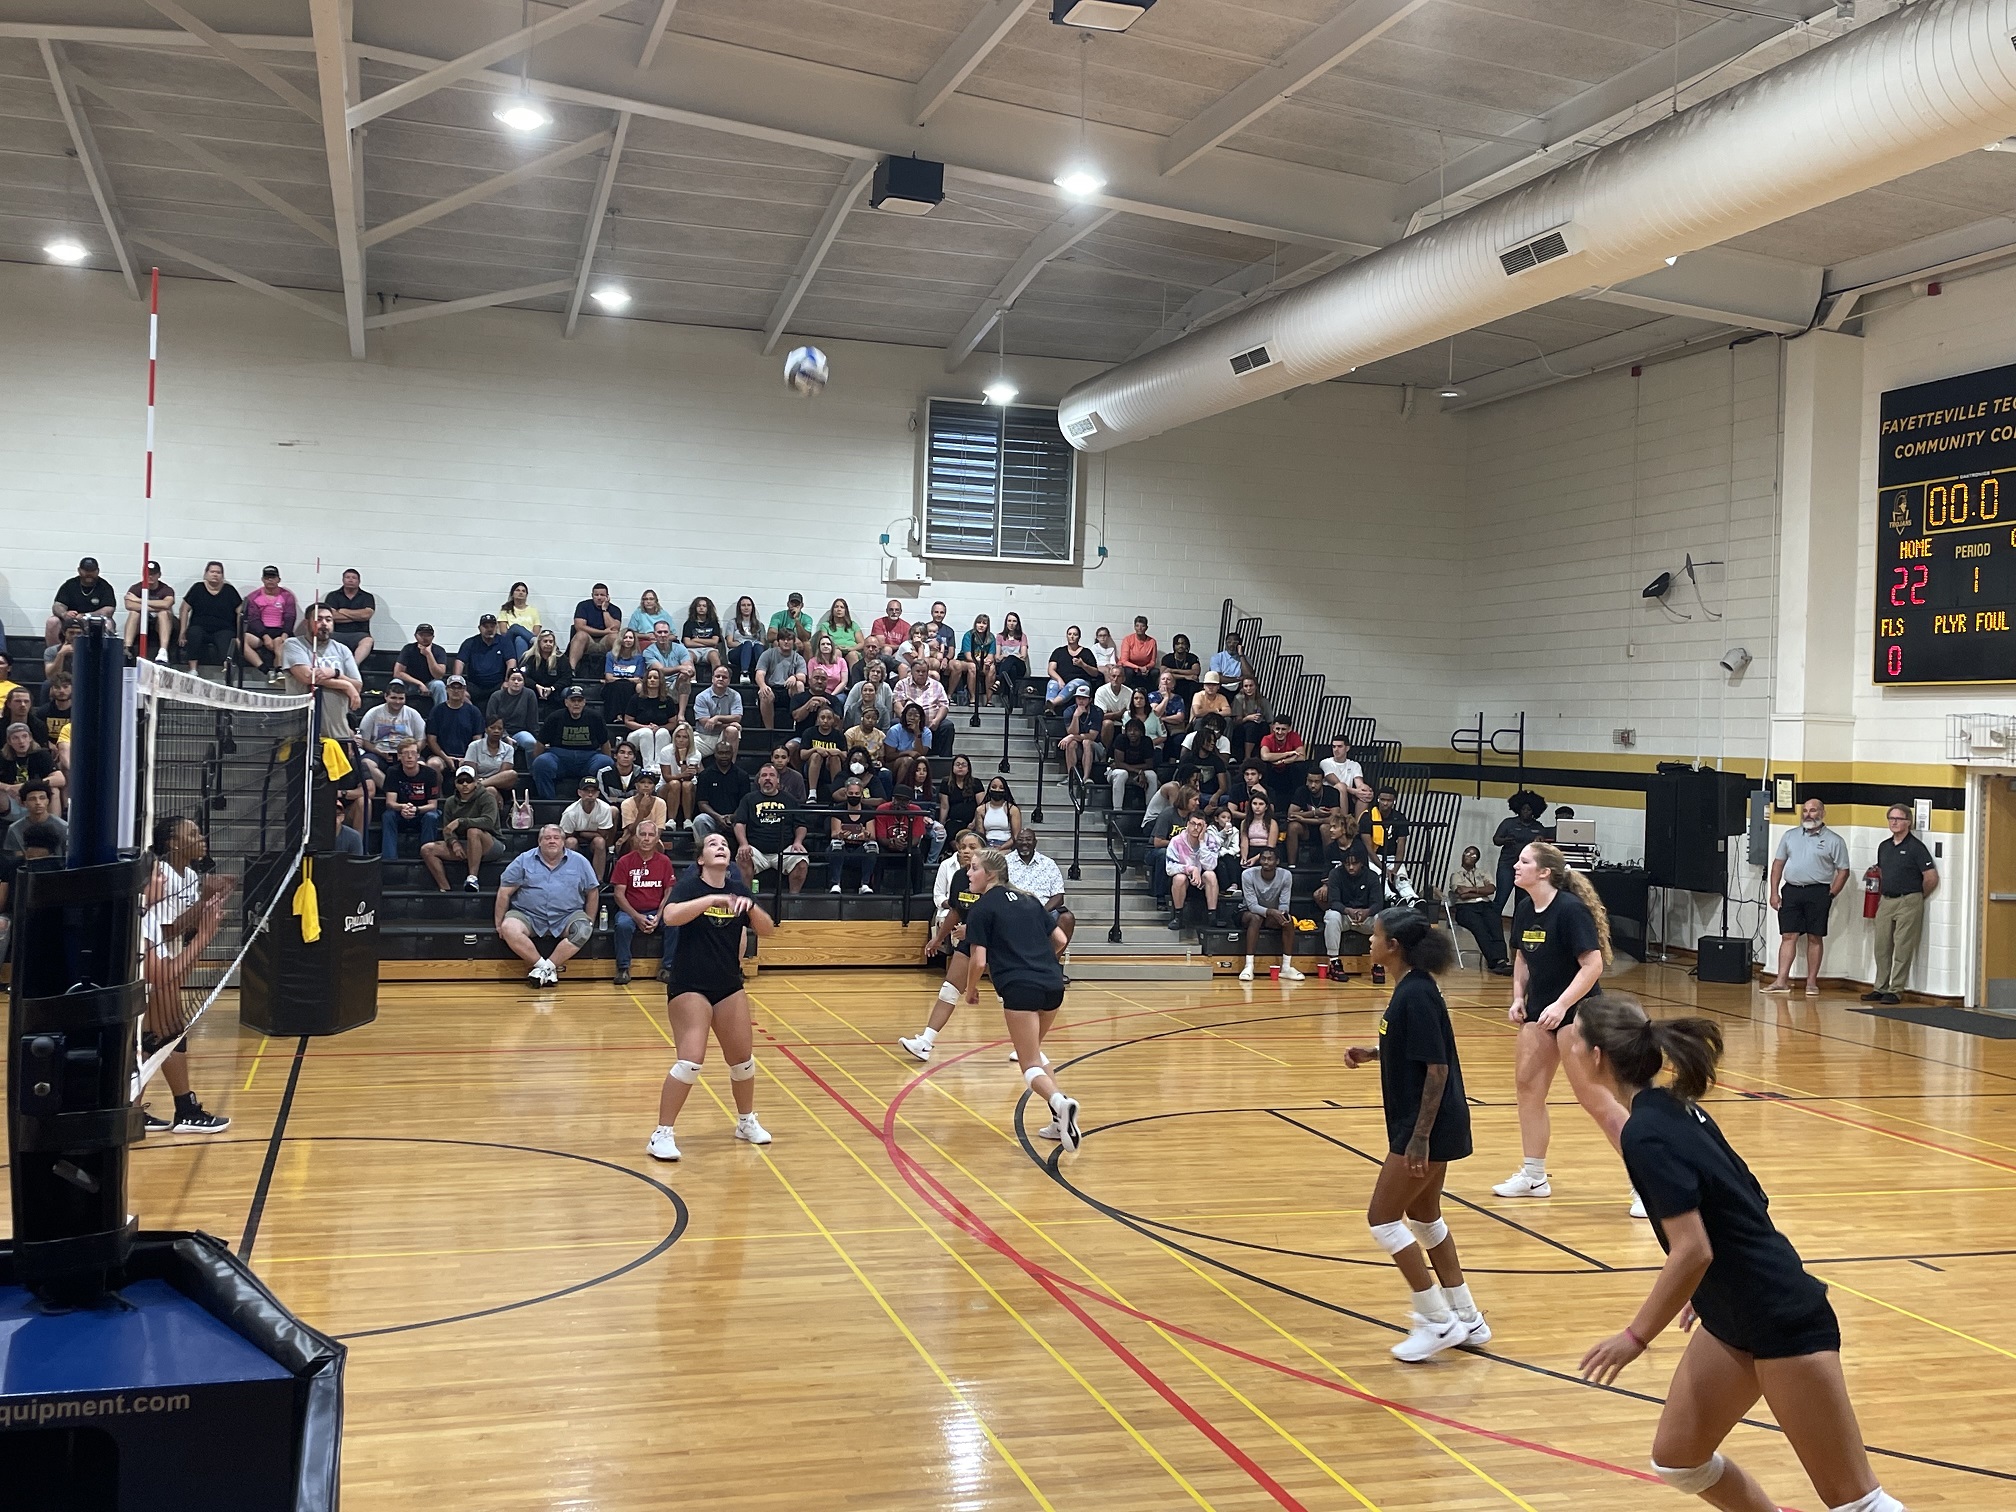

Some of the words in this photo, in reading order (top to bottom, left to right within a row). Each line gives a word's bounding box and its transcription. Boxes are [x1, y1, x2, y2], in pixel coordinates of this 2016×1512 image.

[1881, 401, 1988, 436] FAYETTEVILLE
[1894, 429, 1987, 460] COMMUNITY
[1990, 425, 2016, 443] CO
[1900, 538, 1933, 559] HOME
[1955, 542, 1991, 559] PERIOD
[1890, 564, 1929, 606] 22
[1880, 617, 1906, 637] FLS
[1934, 613, 1967, 634] PLYR
[1975, 610, 2010, 632] FOUL
[1887, 645, 1902, 676] 0
[632, 880, 663, 888] EXAMPLE
[1004, 891, 1019, 902] 10
